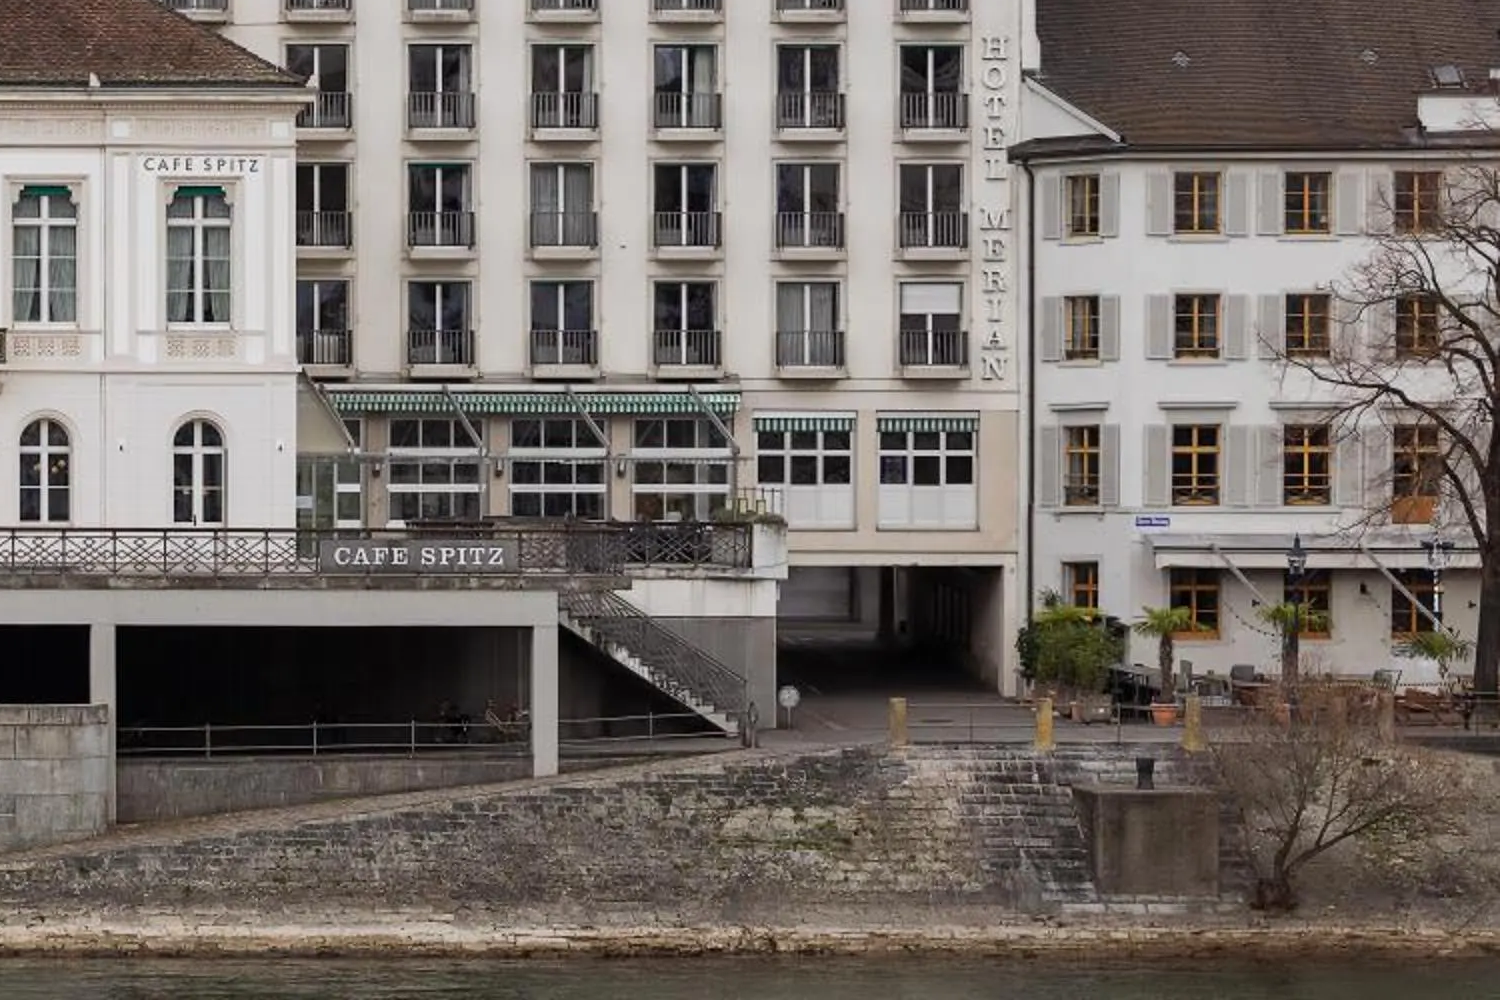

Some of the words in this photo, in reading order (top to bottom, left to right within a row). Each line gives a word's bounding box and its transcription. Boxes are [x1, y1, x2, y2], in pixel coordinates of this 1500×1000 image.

[980, 36, 1008, 180] HOTEL
[142, 157, 193, 172] CAFE
[203, 157, 259, 173] SPITZ
[980, 208, 1012, 381] MERIAN
[332, 547, 409, 566] CAFE
[420, 547, 505, 566] SPITZ
